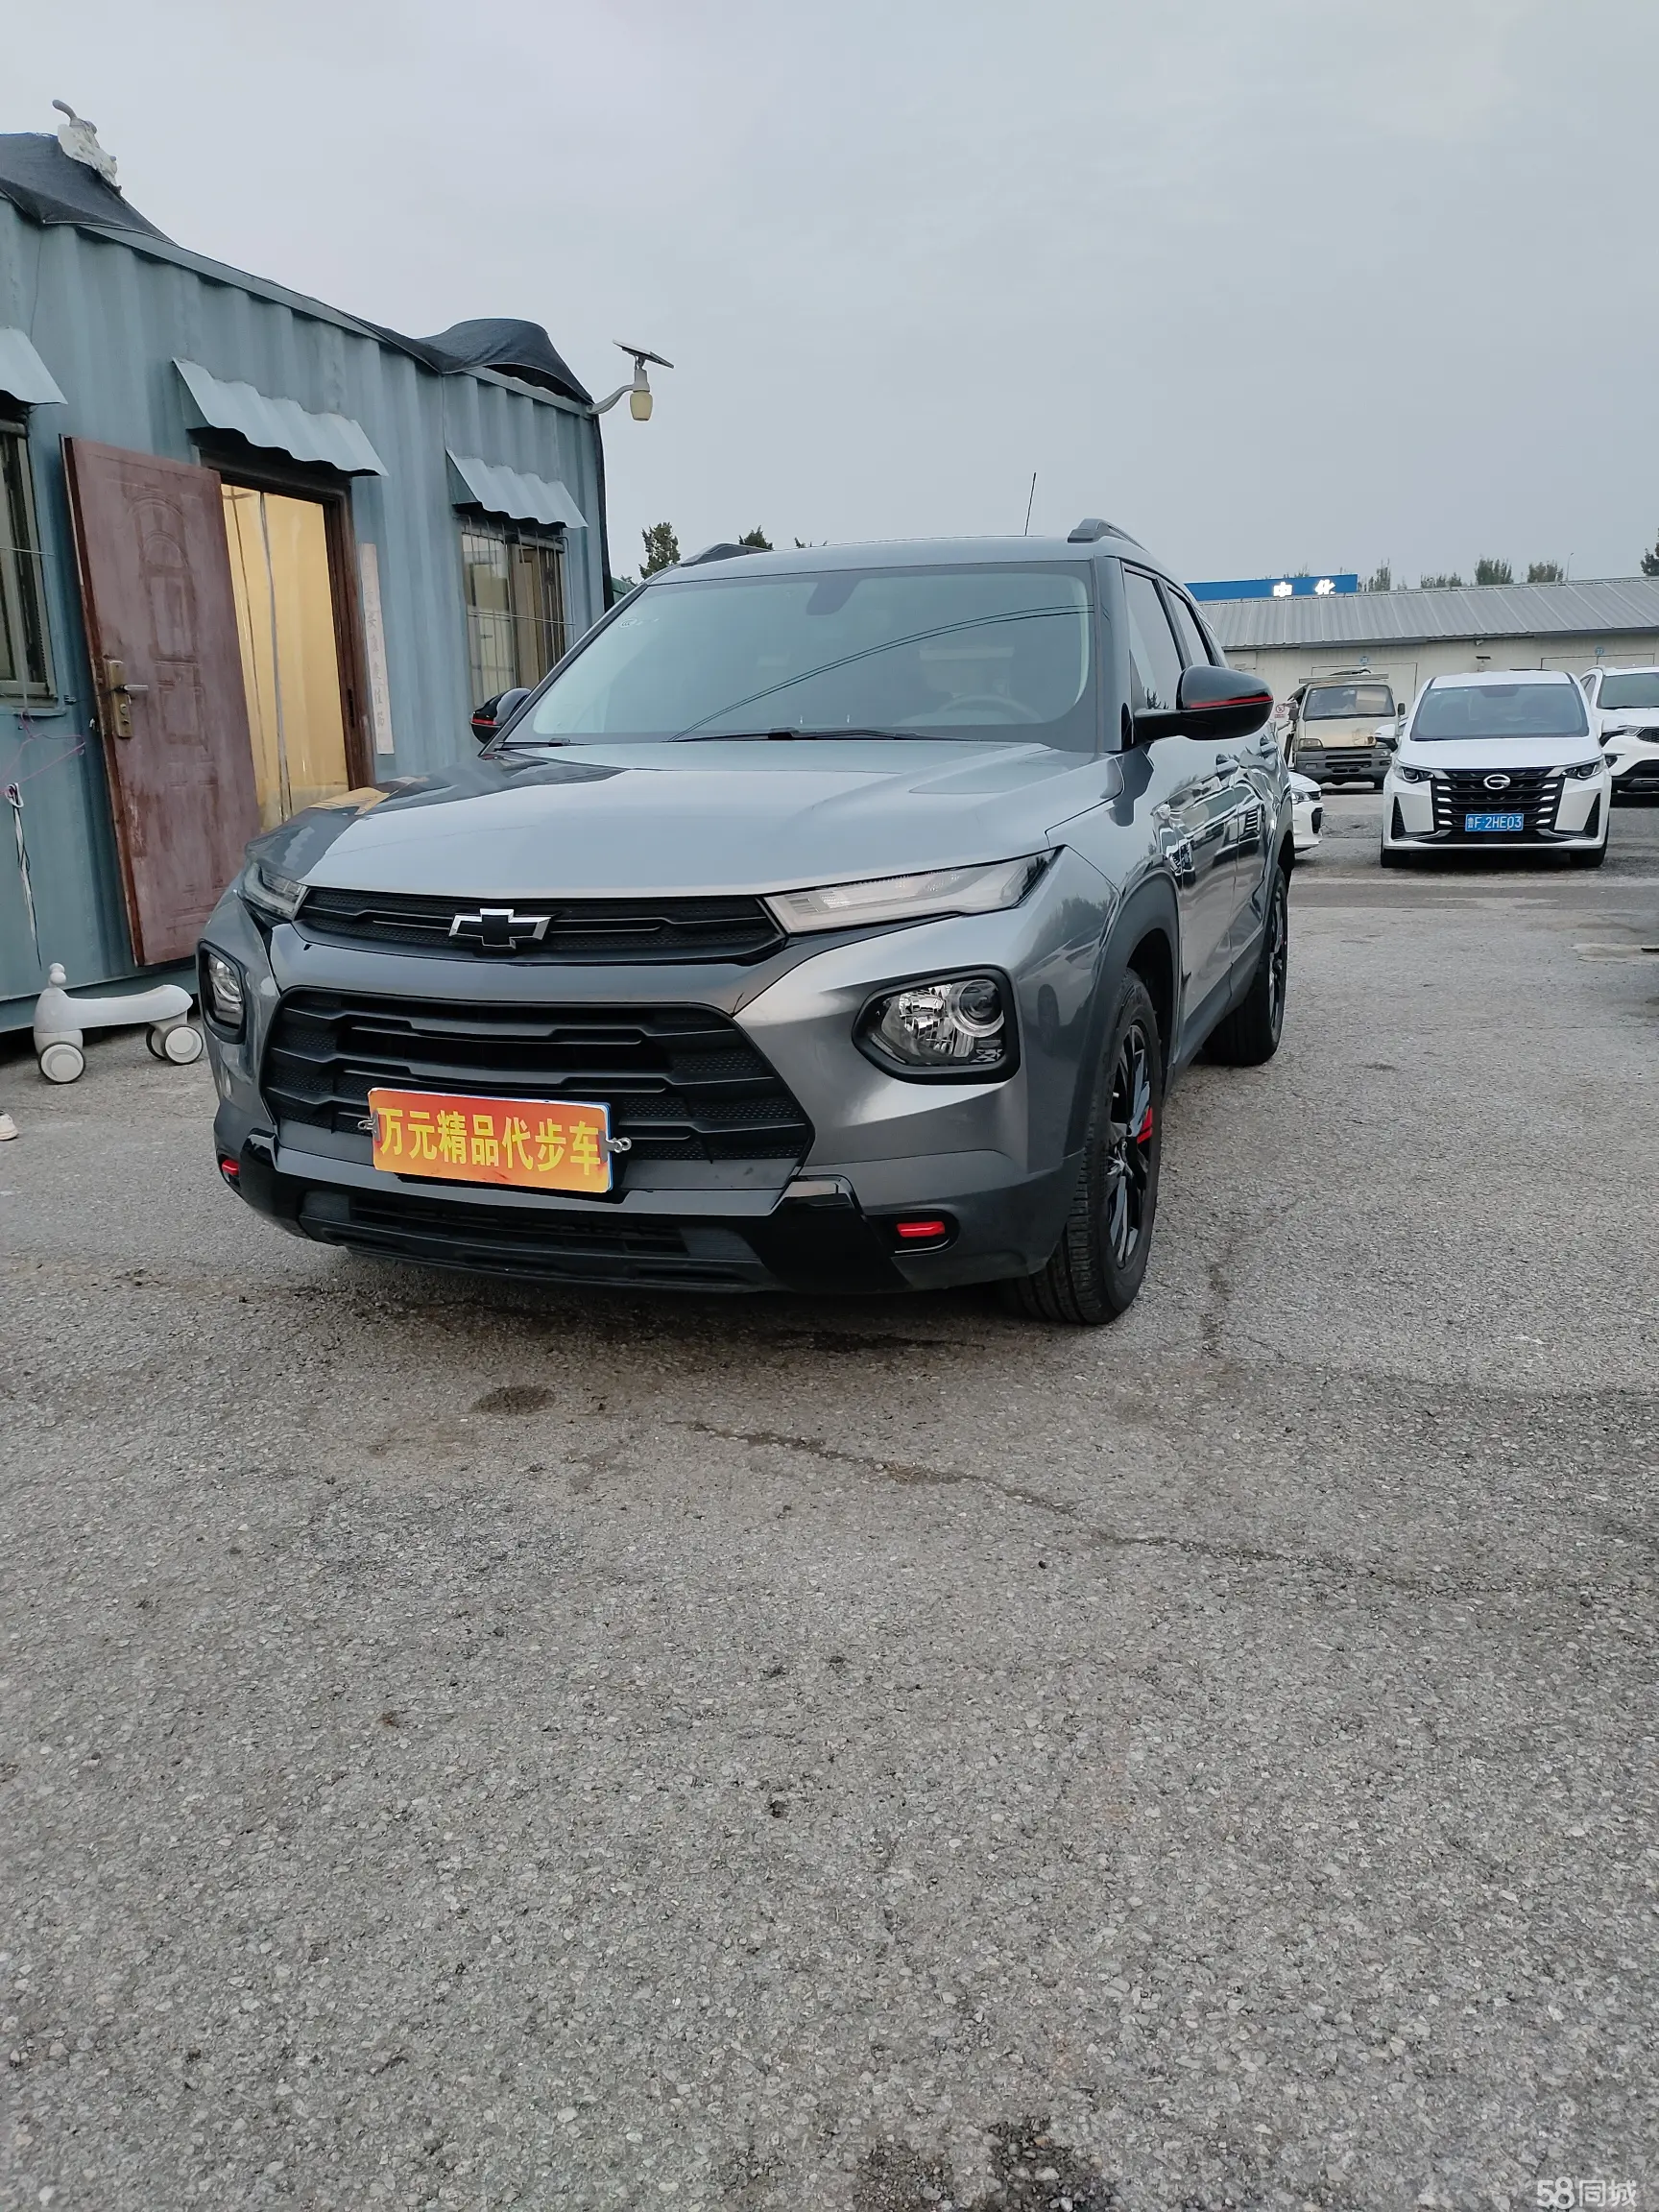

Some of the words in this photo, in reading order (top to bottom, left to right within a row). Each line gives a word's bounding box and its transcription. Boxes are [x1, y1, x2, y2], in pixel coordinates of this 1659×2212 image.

[377, 1107, 601, 1175] 万元精品代步车
